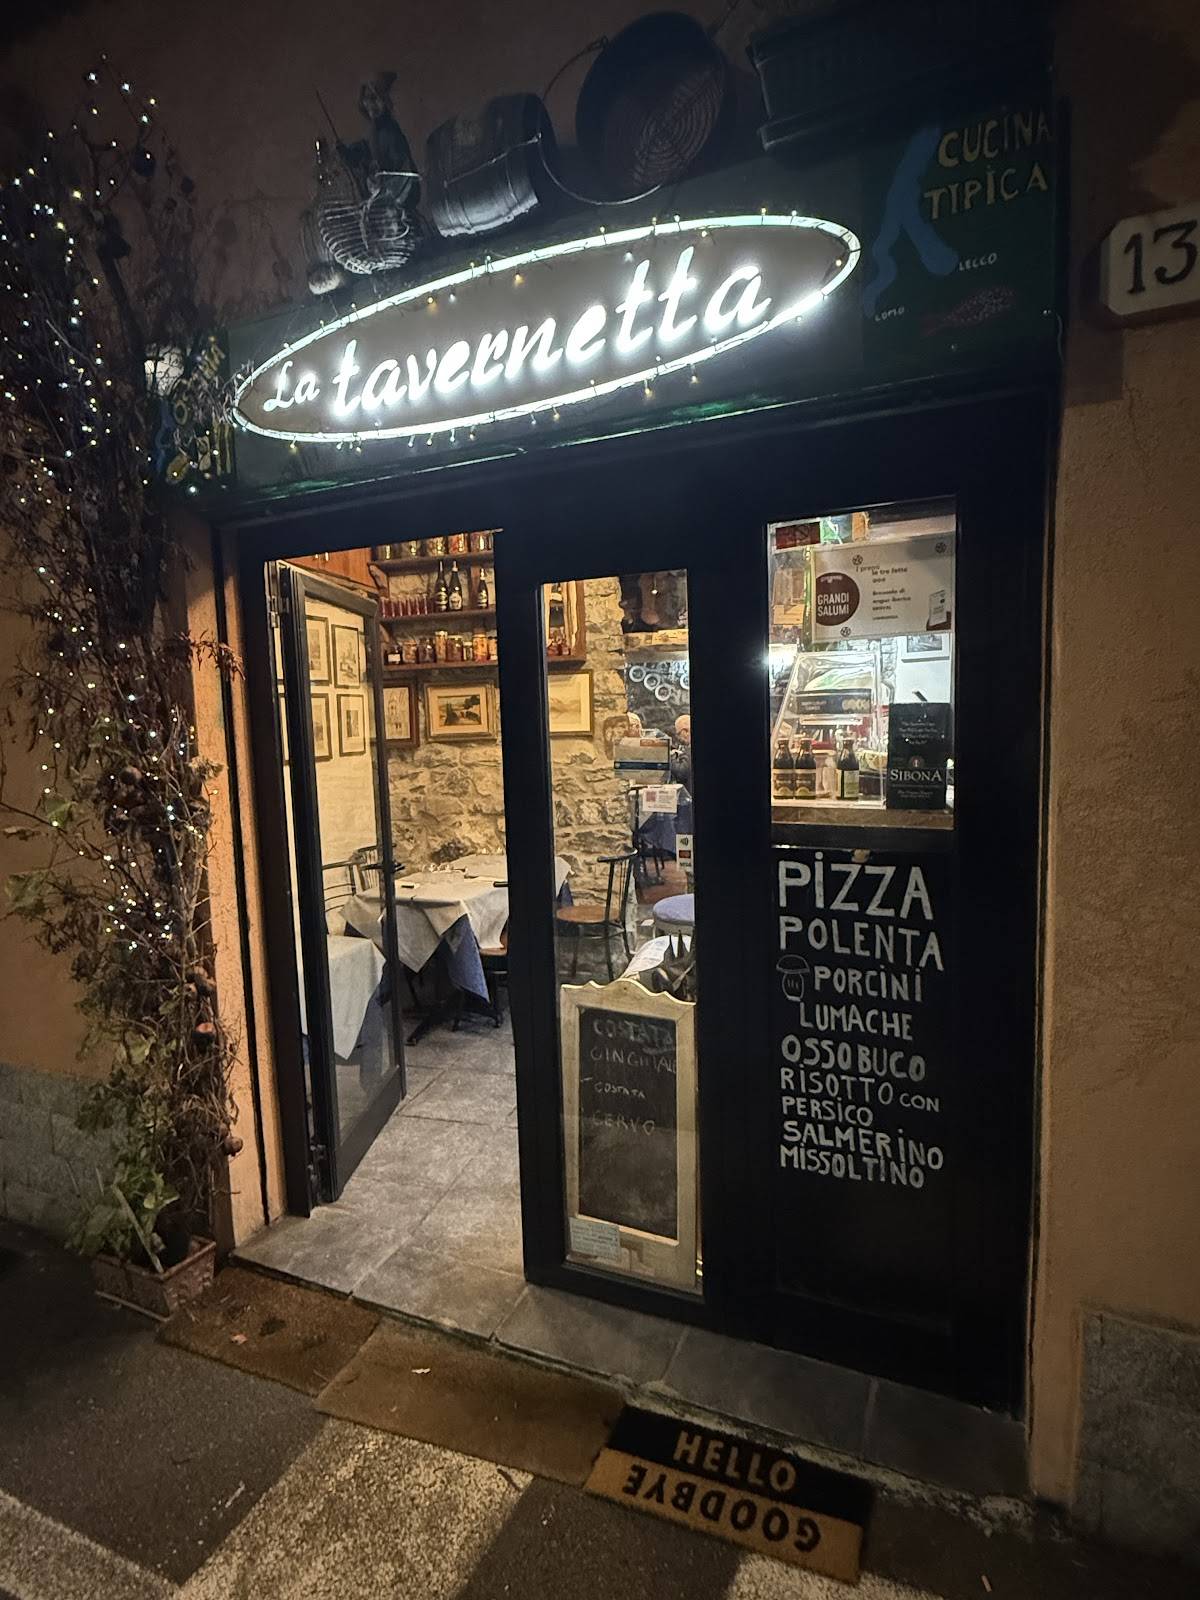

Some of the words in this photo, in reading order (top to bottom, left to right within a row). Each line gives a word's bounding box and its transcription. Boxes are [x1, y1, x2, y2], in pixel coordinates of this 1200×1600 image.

[958, 251, 998, 272] LECCO
[1124, 219, 1198, 294] 13
[263, 360, 321, 412] La
[331, 246, 773, 418] tavernetta
[817, 592, 849, 606] GRANDI
[817, 604, 849, 617] SALUMI
[889, 768, 944, 783] SIBONA
[779, 915, 944, 972] POLENTA
[800, 1002, 913, 1041] LUMACHE
[900, 1092, 940, 1113] CON
[672, 1430, 798, 1493] HELLO
[621, 1463, 822, 1554] GOODBYE
